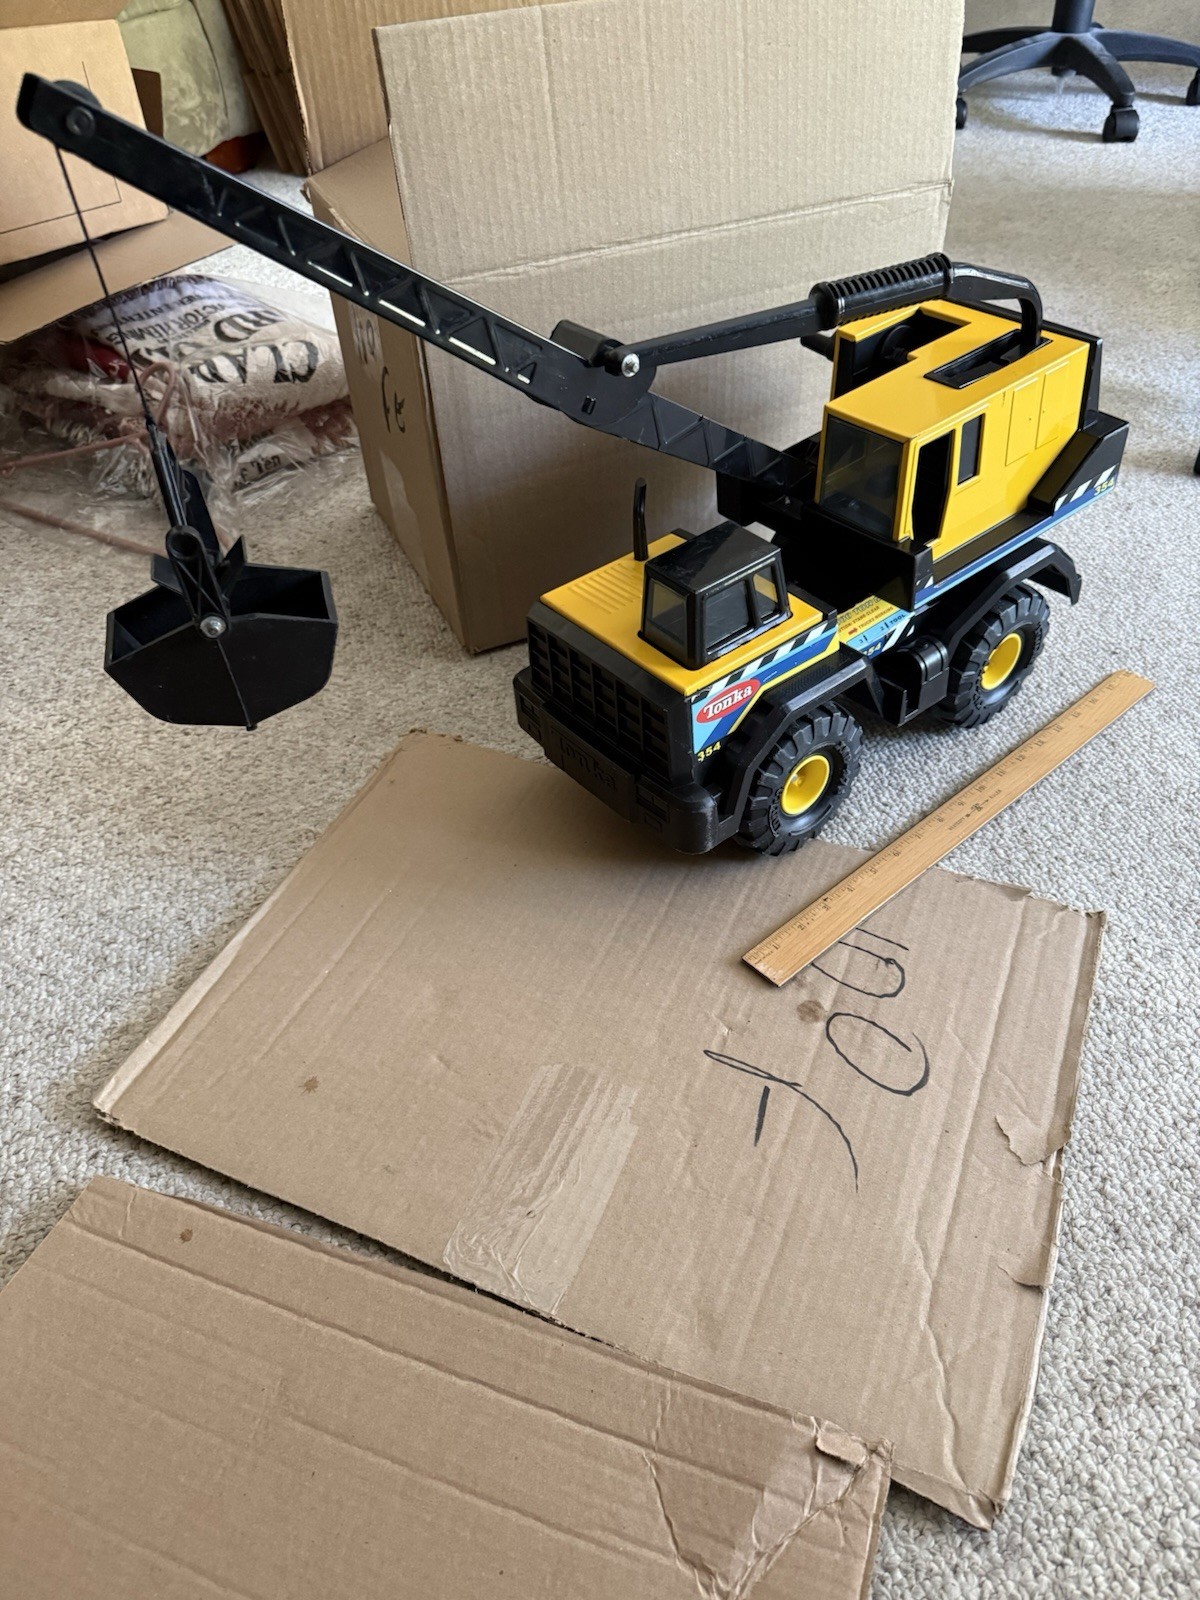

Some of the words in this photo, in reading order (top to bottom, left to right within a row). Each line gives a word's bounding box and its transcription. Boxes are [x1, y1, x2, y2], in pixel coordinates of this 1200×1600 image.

[1094, 477, 1115, 495] 354
[889, 614, 906, 624] TOOL
[703, 685, 753, 719] Tonka
[697, 741, 721, 762] 354
[560, 736, 617, 792] Tonka
